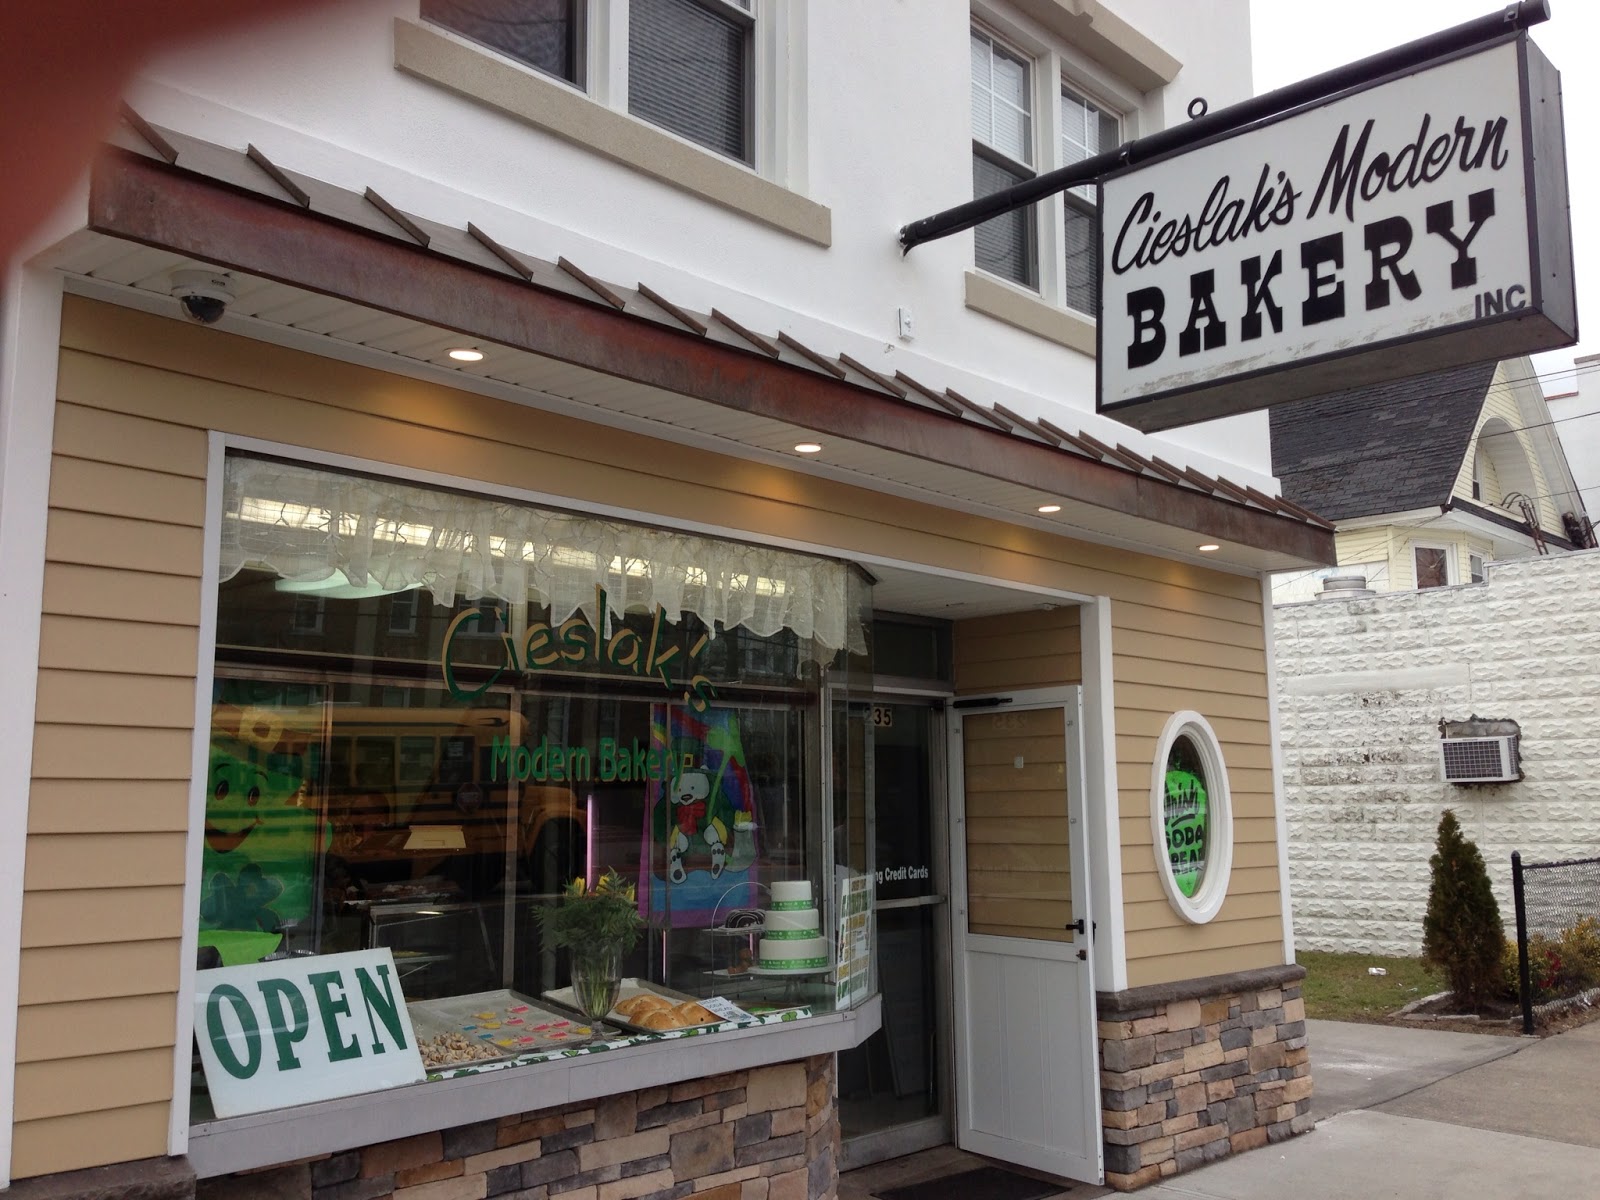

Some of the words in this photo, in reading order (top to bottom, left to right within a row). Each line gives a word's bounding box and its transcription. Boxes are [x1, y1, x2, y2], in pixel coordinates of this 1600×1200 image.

[1111, 163, 1303, 275] Cieslak's
[1306, 112, 1508, 222] Modern
[1126, 187, 1495, 370] BAKERY
[442, 583, 718, 713] Cieslak's
[600, 736, 686, 793] Bakery
[885, 866, 907, 881] Credit
[908, 865, 929, 880] Cards
[206, 964, 408, 1080] OPEN
